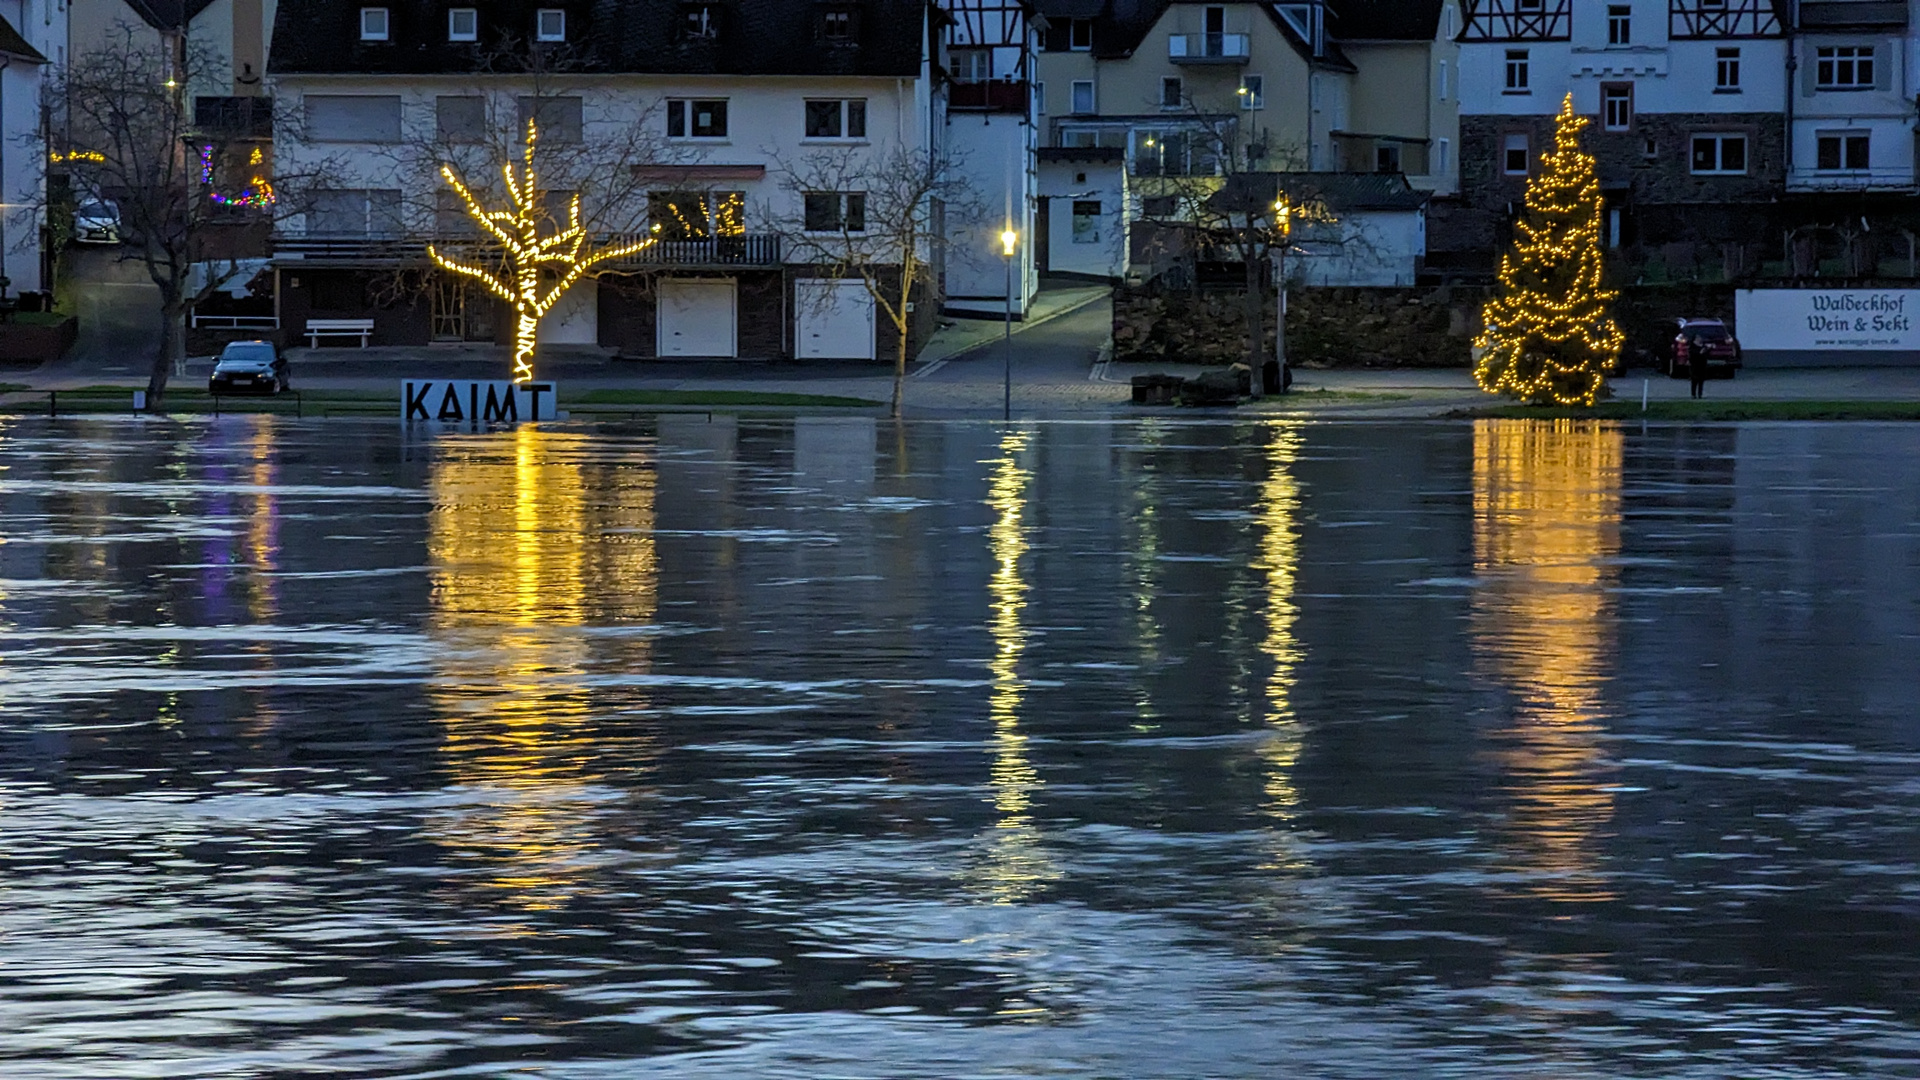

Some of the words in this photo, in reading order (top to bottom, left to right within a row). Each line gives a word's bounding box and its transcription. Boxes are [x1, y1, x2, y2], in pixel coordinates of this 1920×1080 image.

[1812, 294, 1906, 314] Waldeckhof
[1807, 315, 1849, 332] Wein
[1854, 317, 1868, 332] &
[1871, 315, 1910, 332] Sekt
[406, 382, 552, 422] KAIMT
